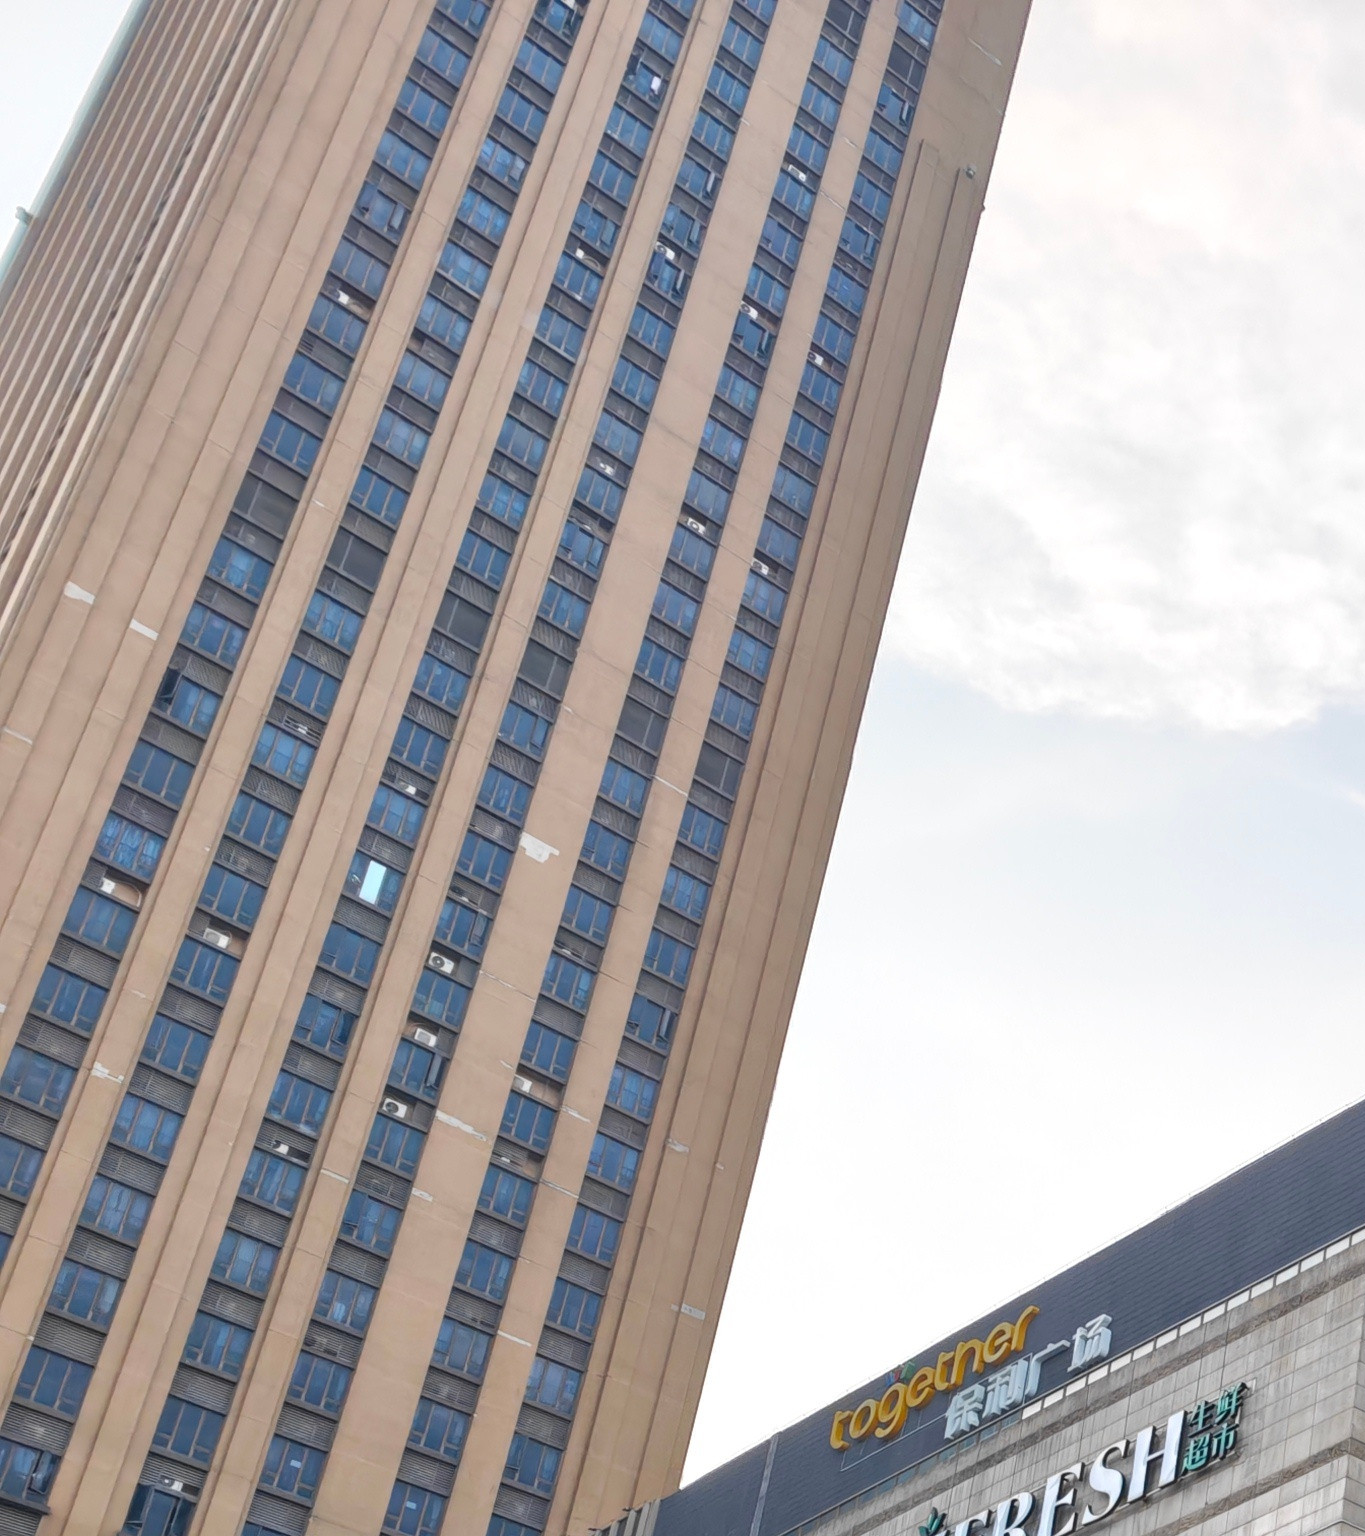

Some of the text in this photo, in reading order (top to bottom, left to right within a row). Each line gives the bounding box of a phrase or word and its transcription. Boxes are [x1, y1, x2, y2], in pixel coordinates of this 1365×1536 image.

[943, 1313, 1113, 1440] 保利广场
[1188, 1382, 1247, 1434] 生鲜
[1181, 1422, 1240, 1474] 超市
